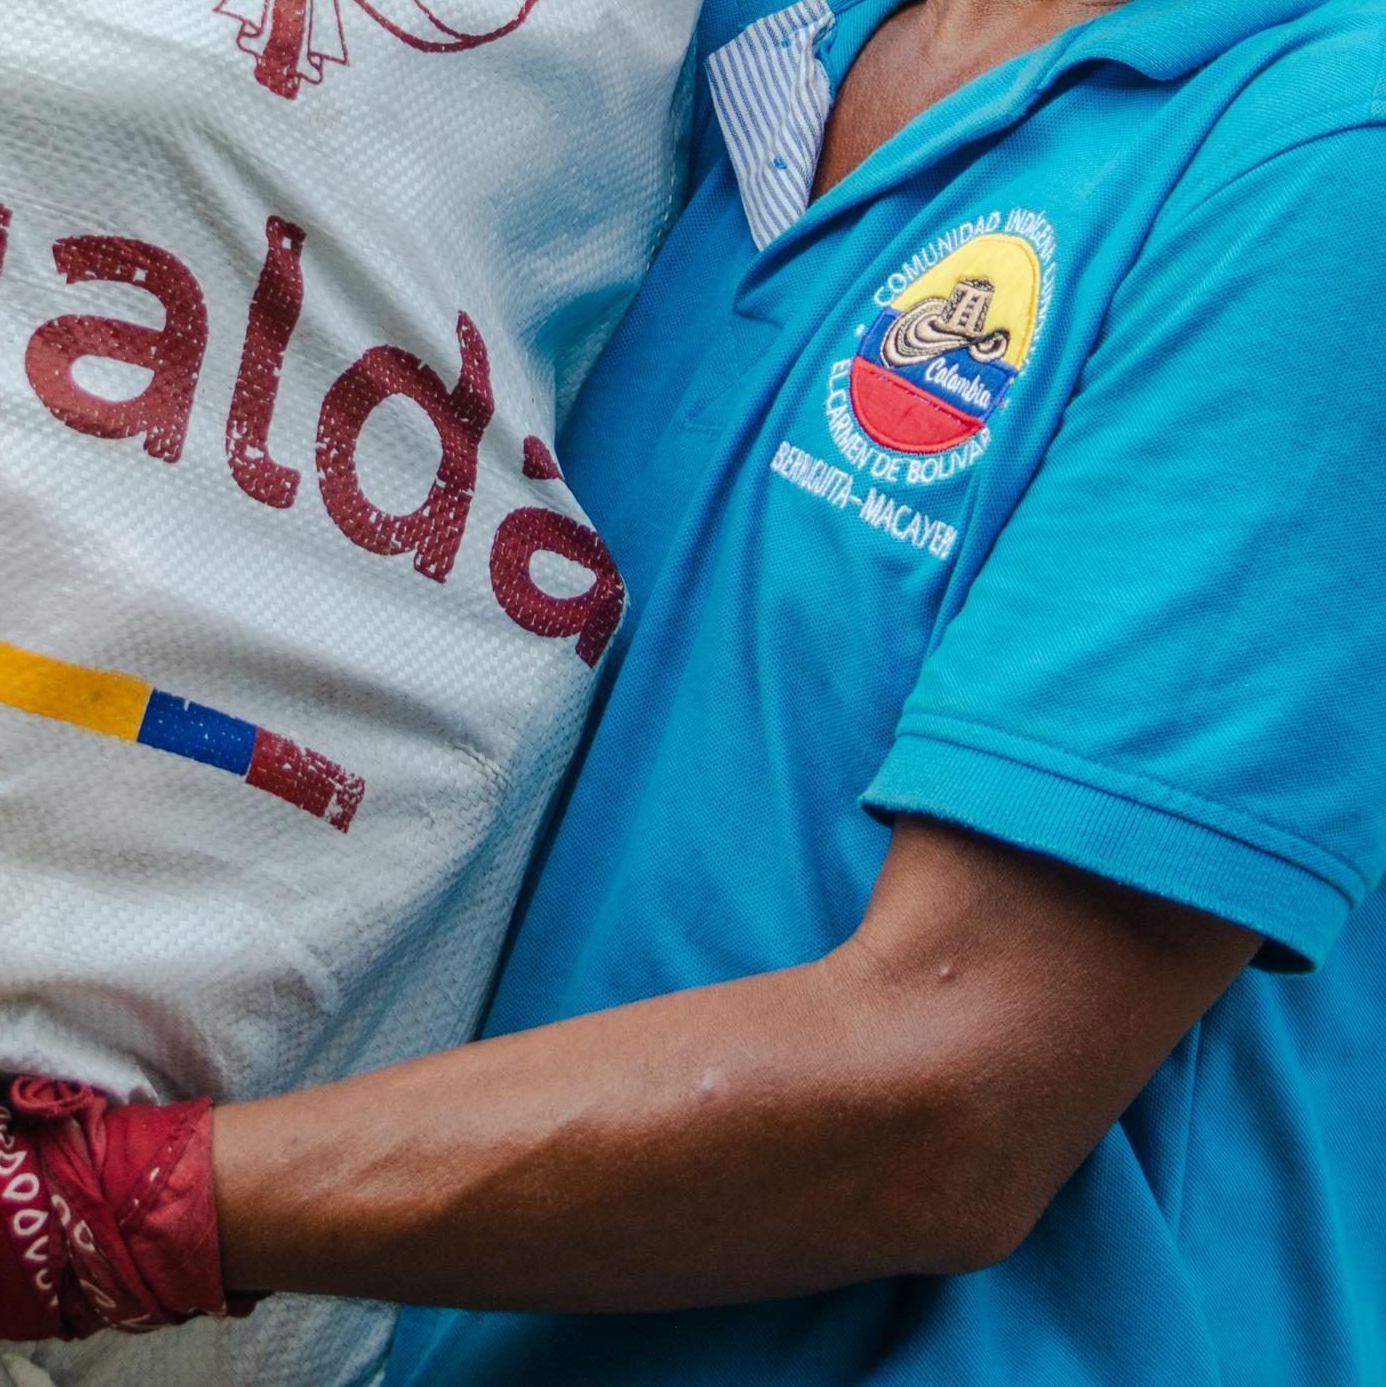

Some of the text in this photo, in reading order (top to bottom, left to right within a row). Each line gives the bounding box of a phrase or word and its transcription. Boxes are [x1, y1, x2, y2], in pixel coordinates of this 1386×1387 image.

[873, 210, 1001, 307] COMUNIDAD
[828, 358, 852, 394] EL
[924, 356, 992, 410] Colombia
[825, 388, 875, 470] CARMEN
[870, 451, 905, 483] DE
